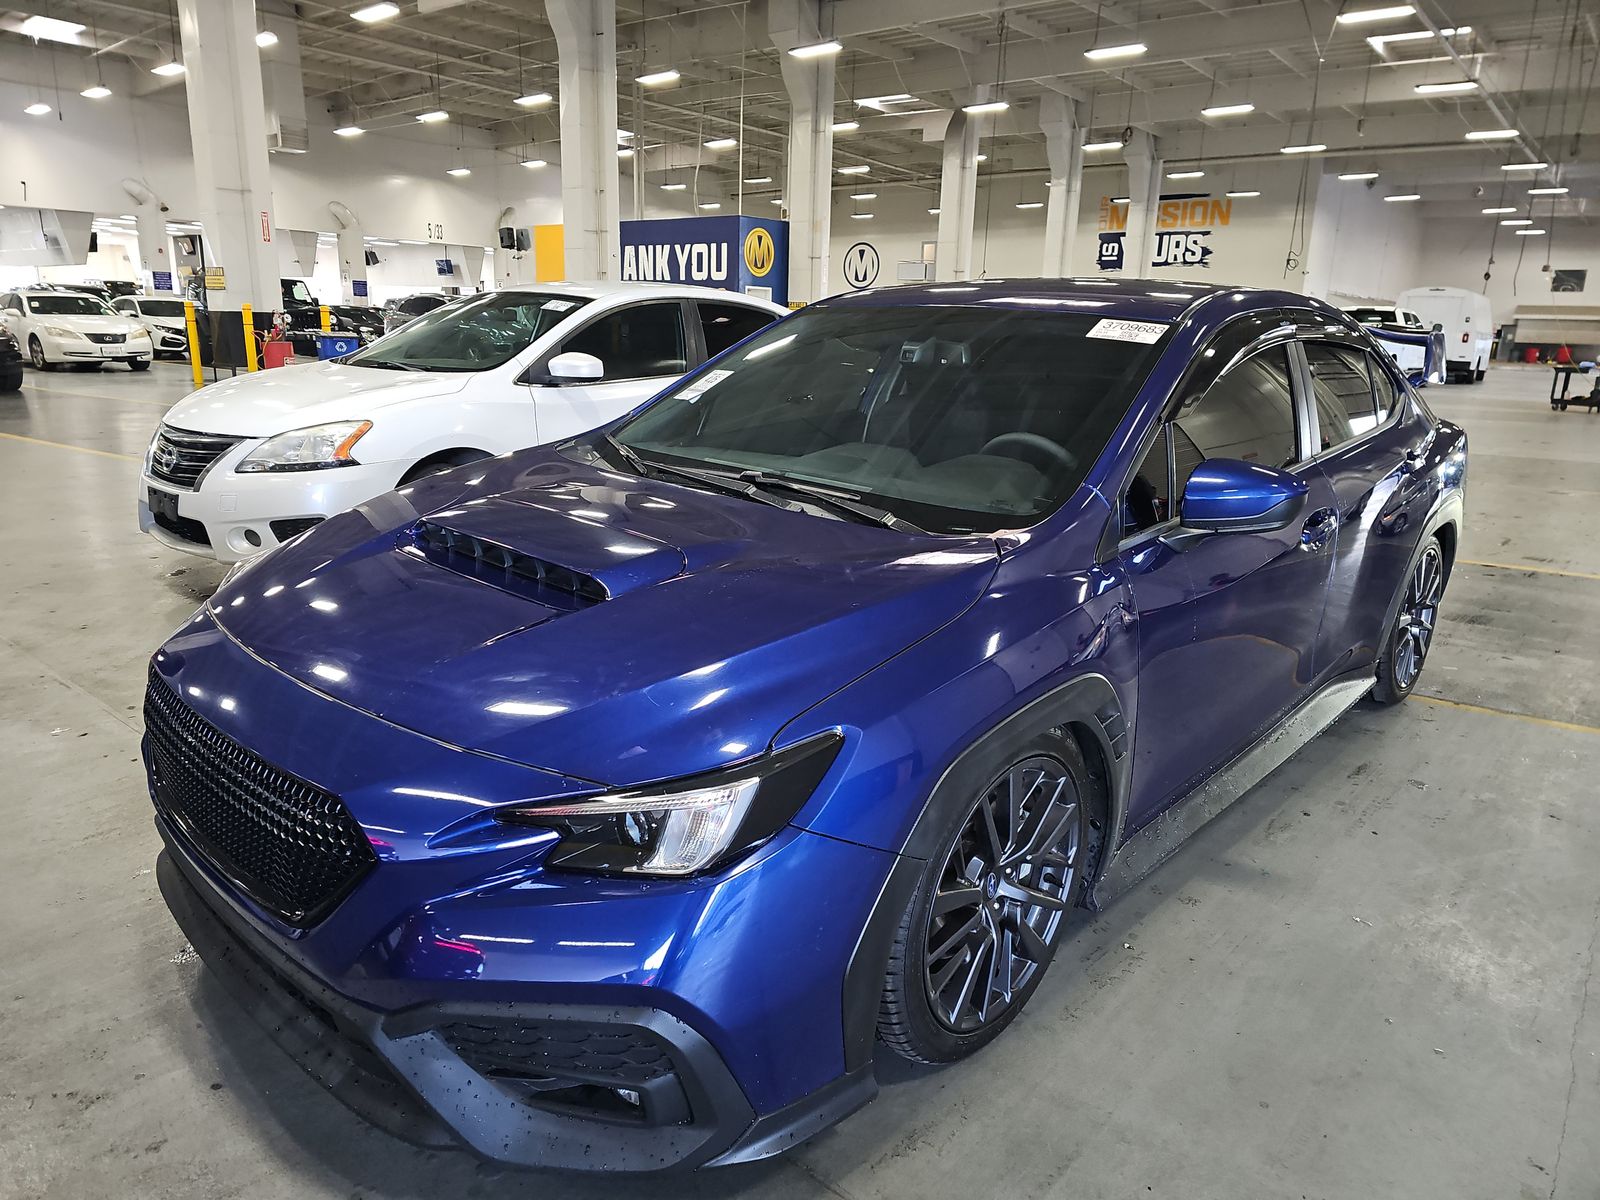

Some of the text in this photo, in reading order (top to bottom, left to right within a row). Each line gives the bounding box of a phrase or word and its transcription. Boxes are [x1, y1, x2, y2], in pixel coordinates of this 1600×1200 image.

[1108, 199, 1232, 230] MSION
[674, 242, 728, 281] YOU
[1101, 242, 1119, 261] IS
[1120, 234, 1204, 263] URS
[1102, 321, 1166, 335] 3709683
